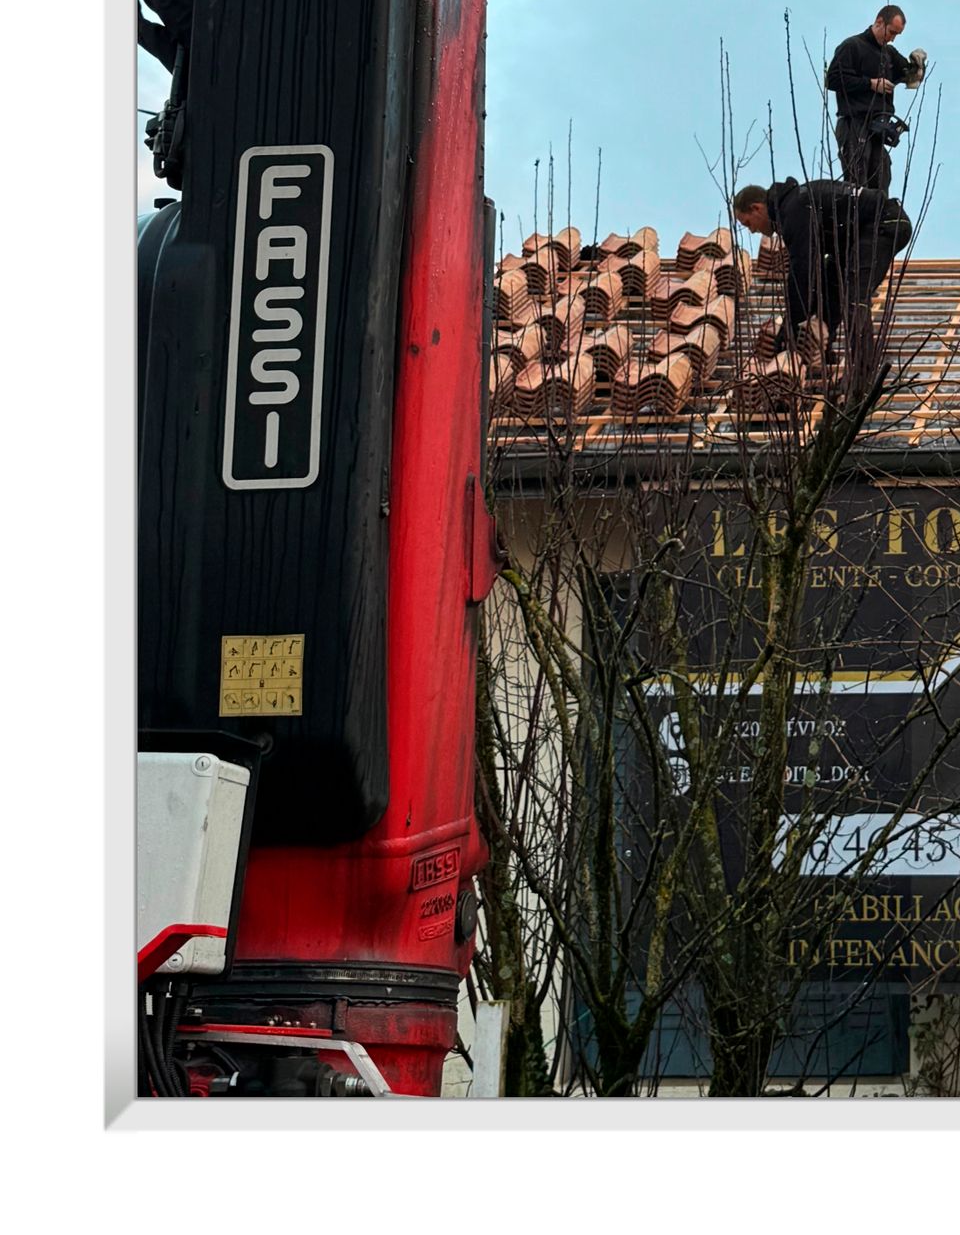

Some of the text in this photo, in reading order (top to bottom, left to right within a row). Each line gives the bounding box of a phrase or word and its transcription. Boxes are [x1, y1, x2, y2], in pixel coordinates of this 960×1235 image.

[248, 164, 311, 468] FASSI
[843, 826, 889, 864] 46
[901, 826, 948, 862] 45
